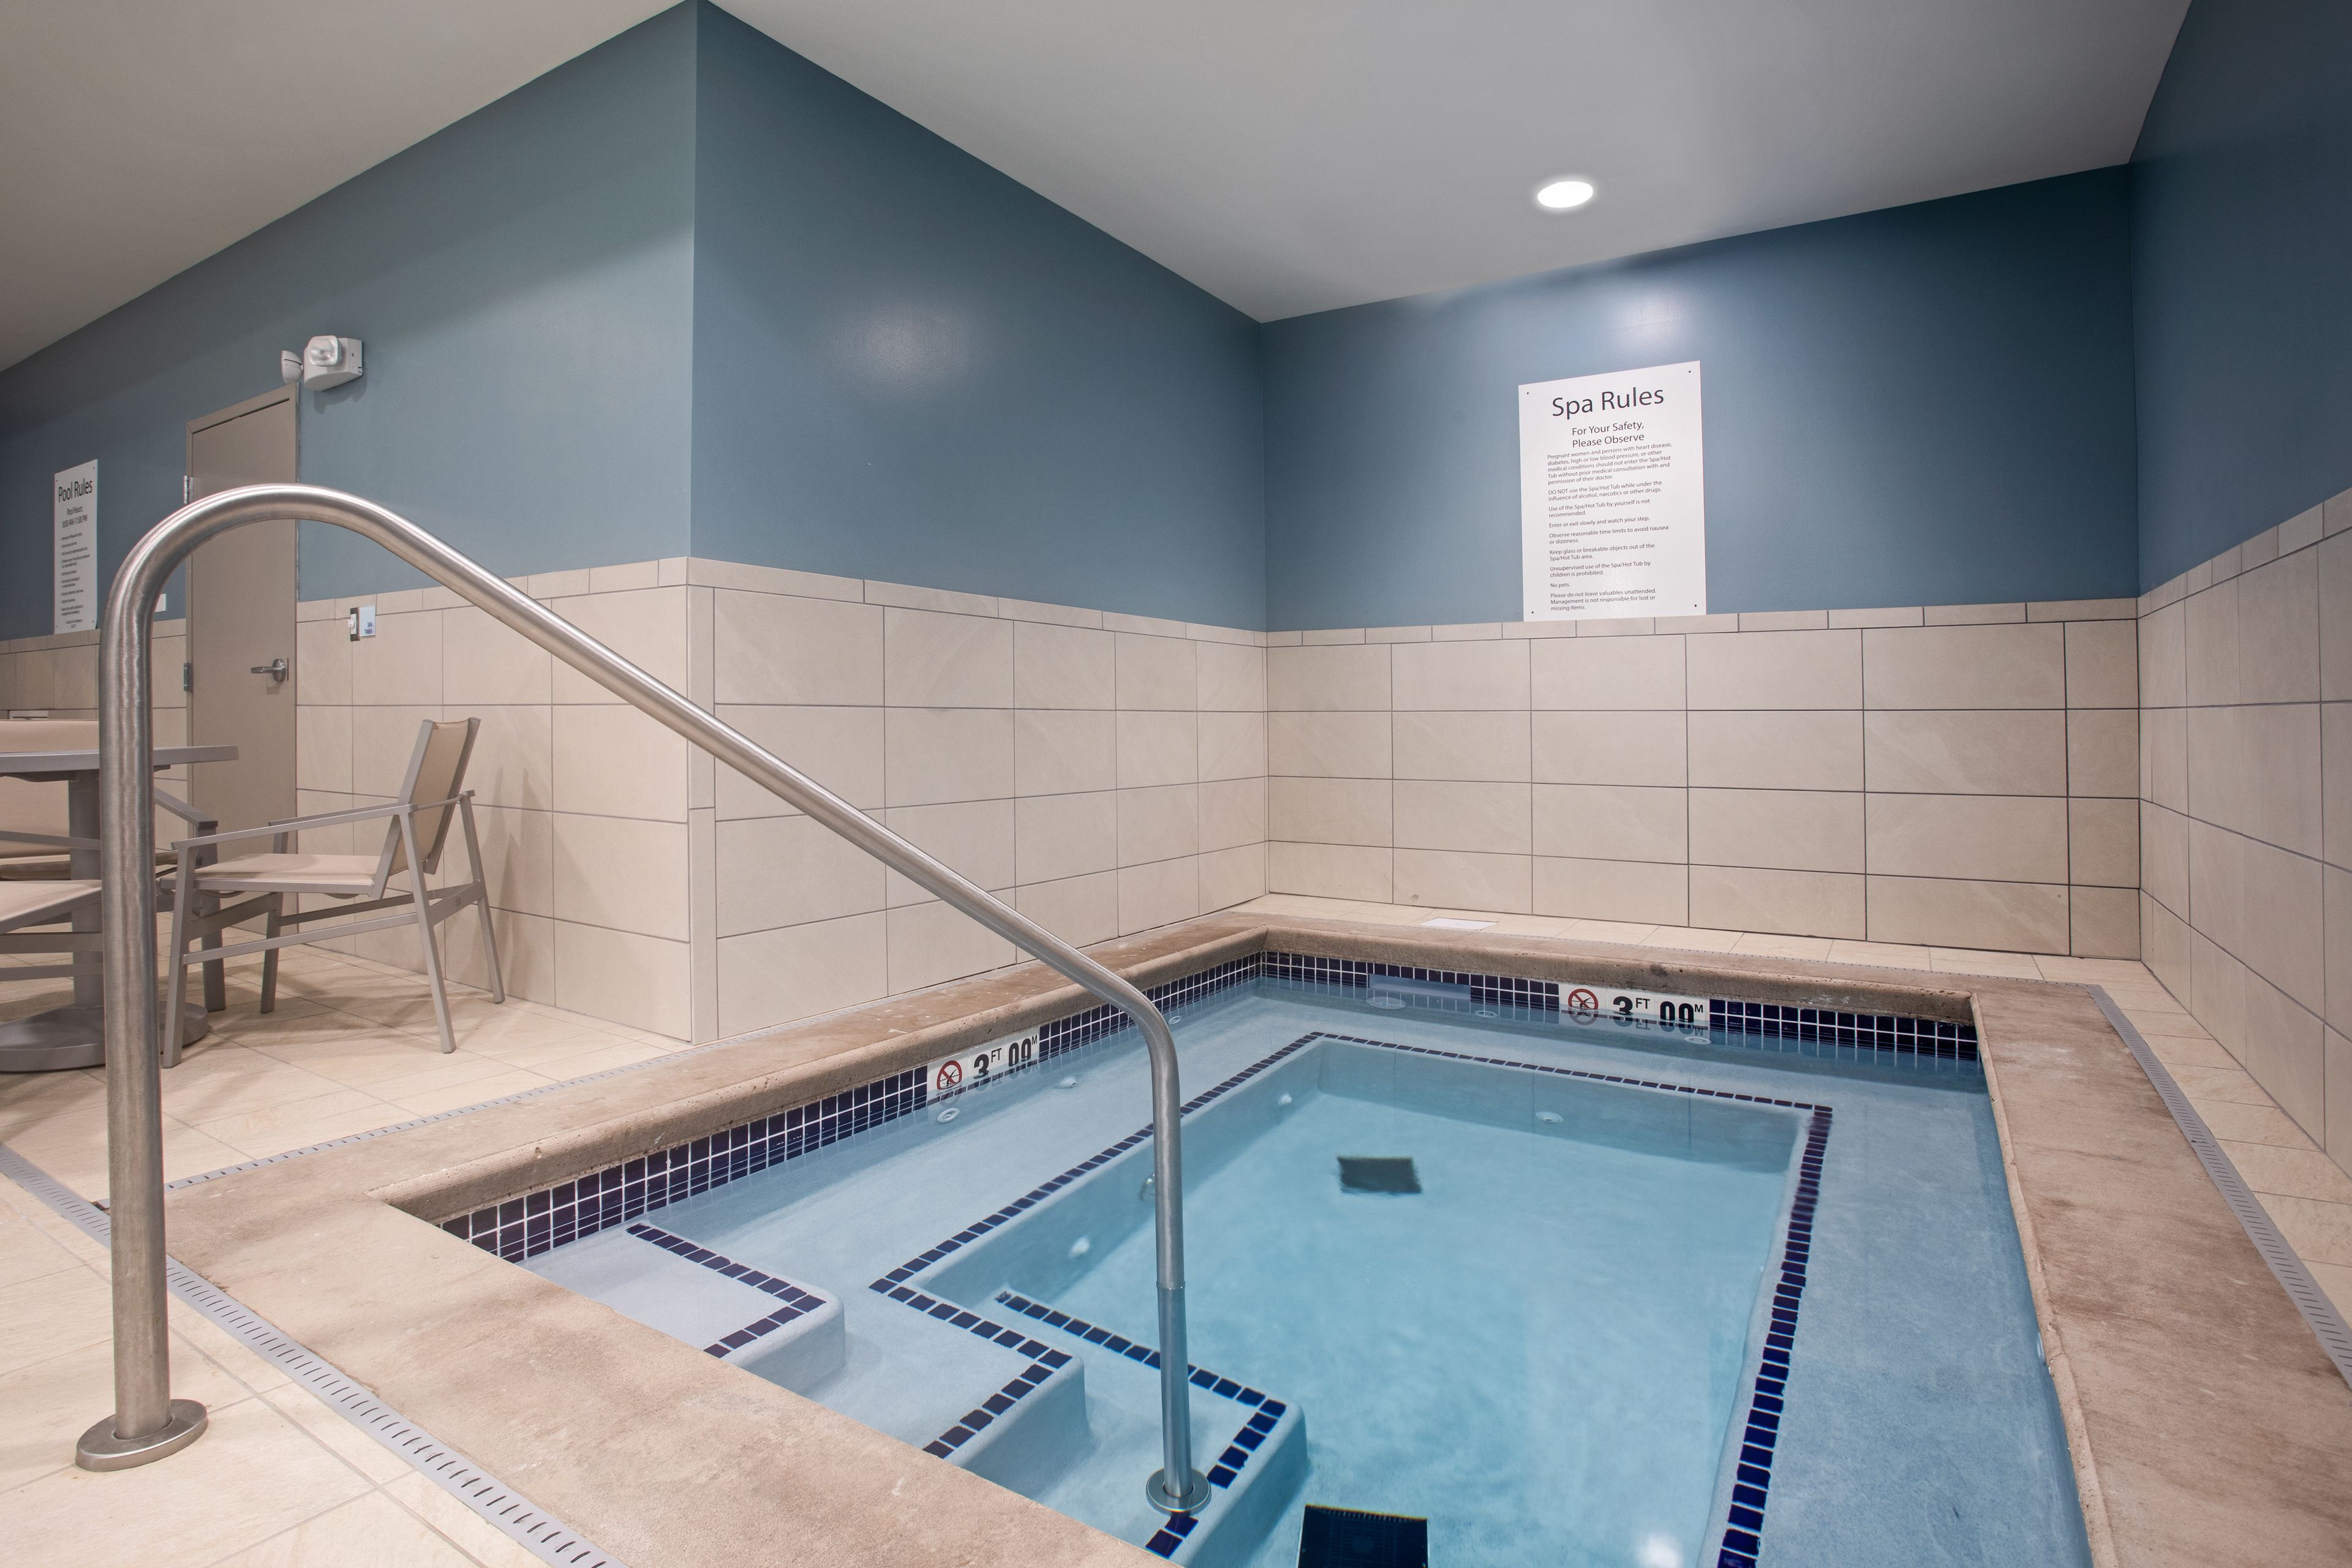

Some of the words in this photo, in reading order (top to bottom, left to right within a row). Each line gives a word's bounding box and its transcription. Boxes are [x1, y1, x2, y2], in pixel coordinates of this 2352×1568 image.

[1552, 397, 1593, 420] Spa
[1601, 386, 1664, 410] Rules
[1588, 425, 1610, 434] Your
[1612, 421, 1644, 431] Safety,
[1572, 439, 1602, 448] Please
[1604, 434, 1645, 444] Observe
[58, 482, 73, 503] Pool
[74, 478, 92, 498] Rules
[1613, 996, 1634, 1016] 3
[1635, 997, 1651, 1009] FT
[1694, 1004, 1703, 1013] M
[973, 1054, 990, 1079] 3
[991, 1047, 1002, 1063] FT
[1031, 1035, 1038, 1045] M
